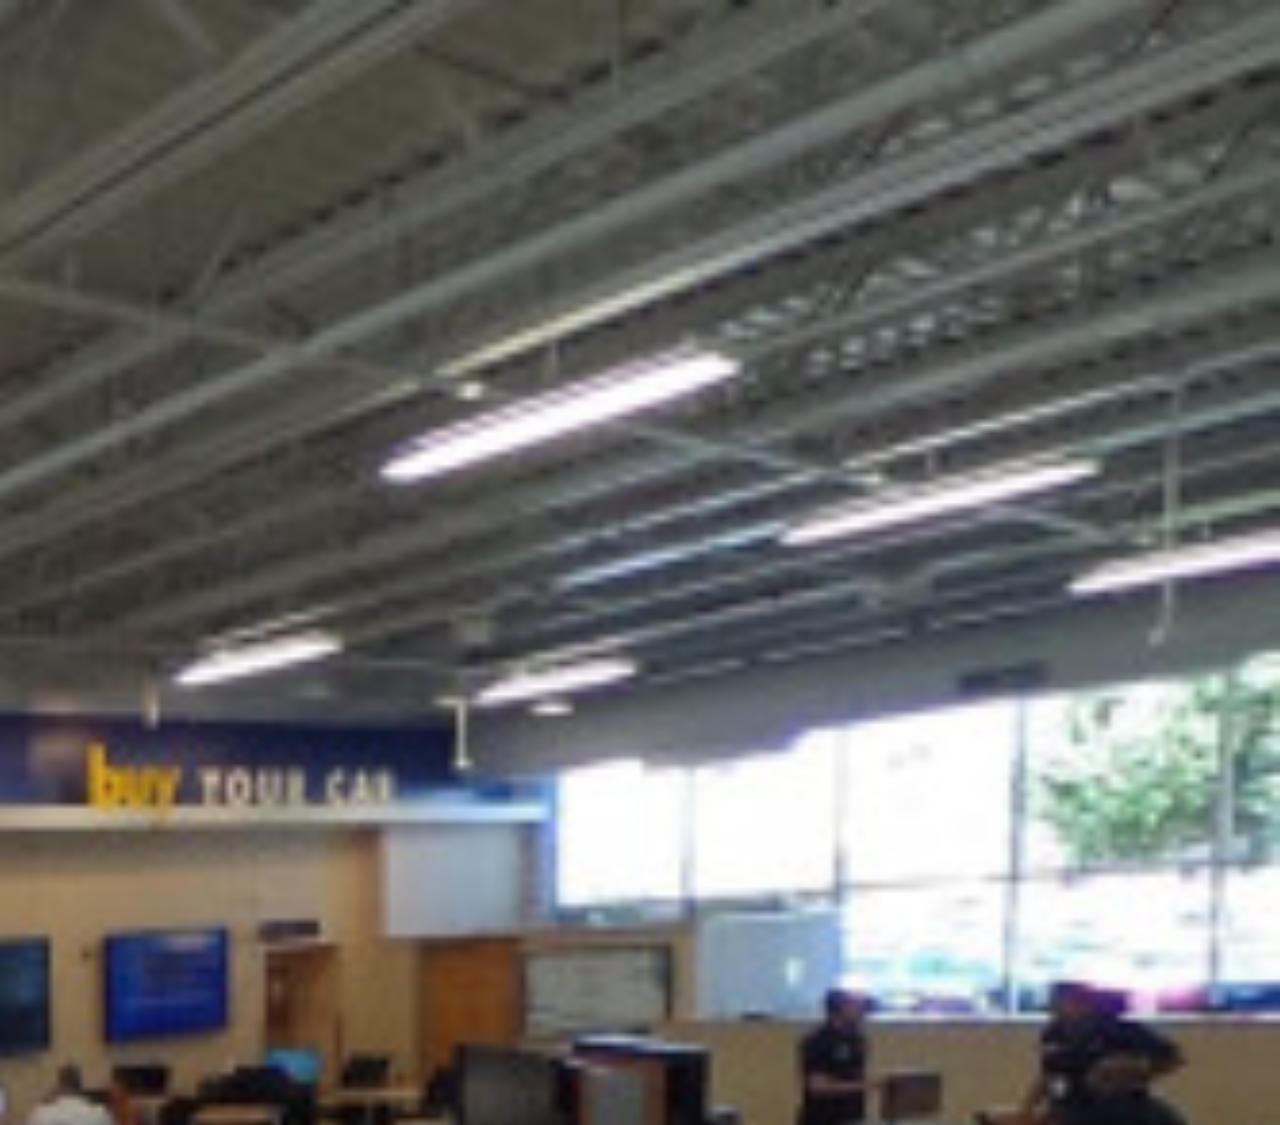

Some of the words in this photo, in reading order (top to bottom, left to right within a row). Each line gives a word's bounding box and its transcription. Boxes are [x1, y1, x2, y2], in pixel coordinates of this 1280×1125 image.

[87, 741, 180, 828] buy
[198, 765, 307, 807] YOUR
[325, 765, 397, 807] CAR
